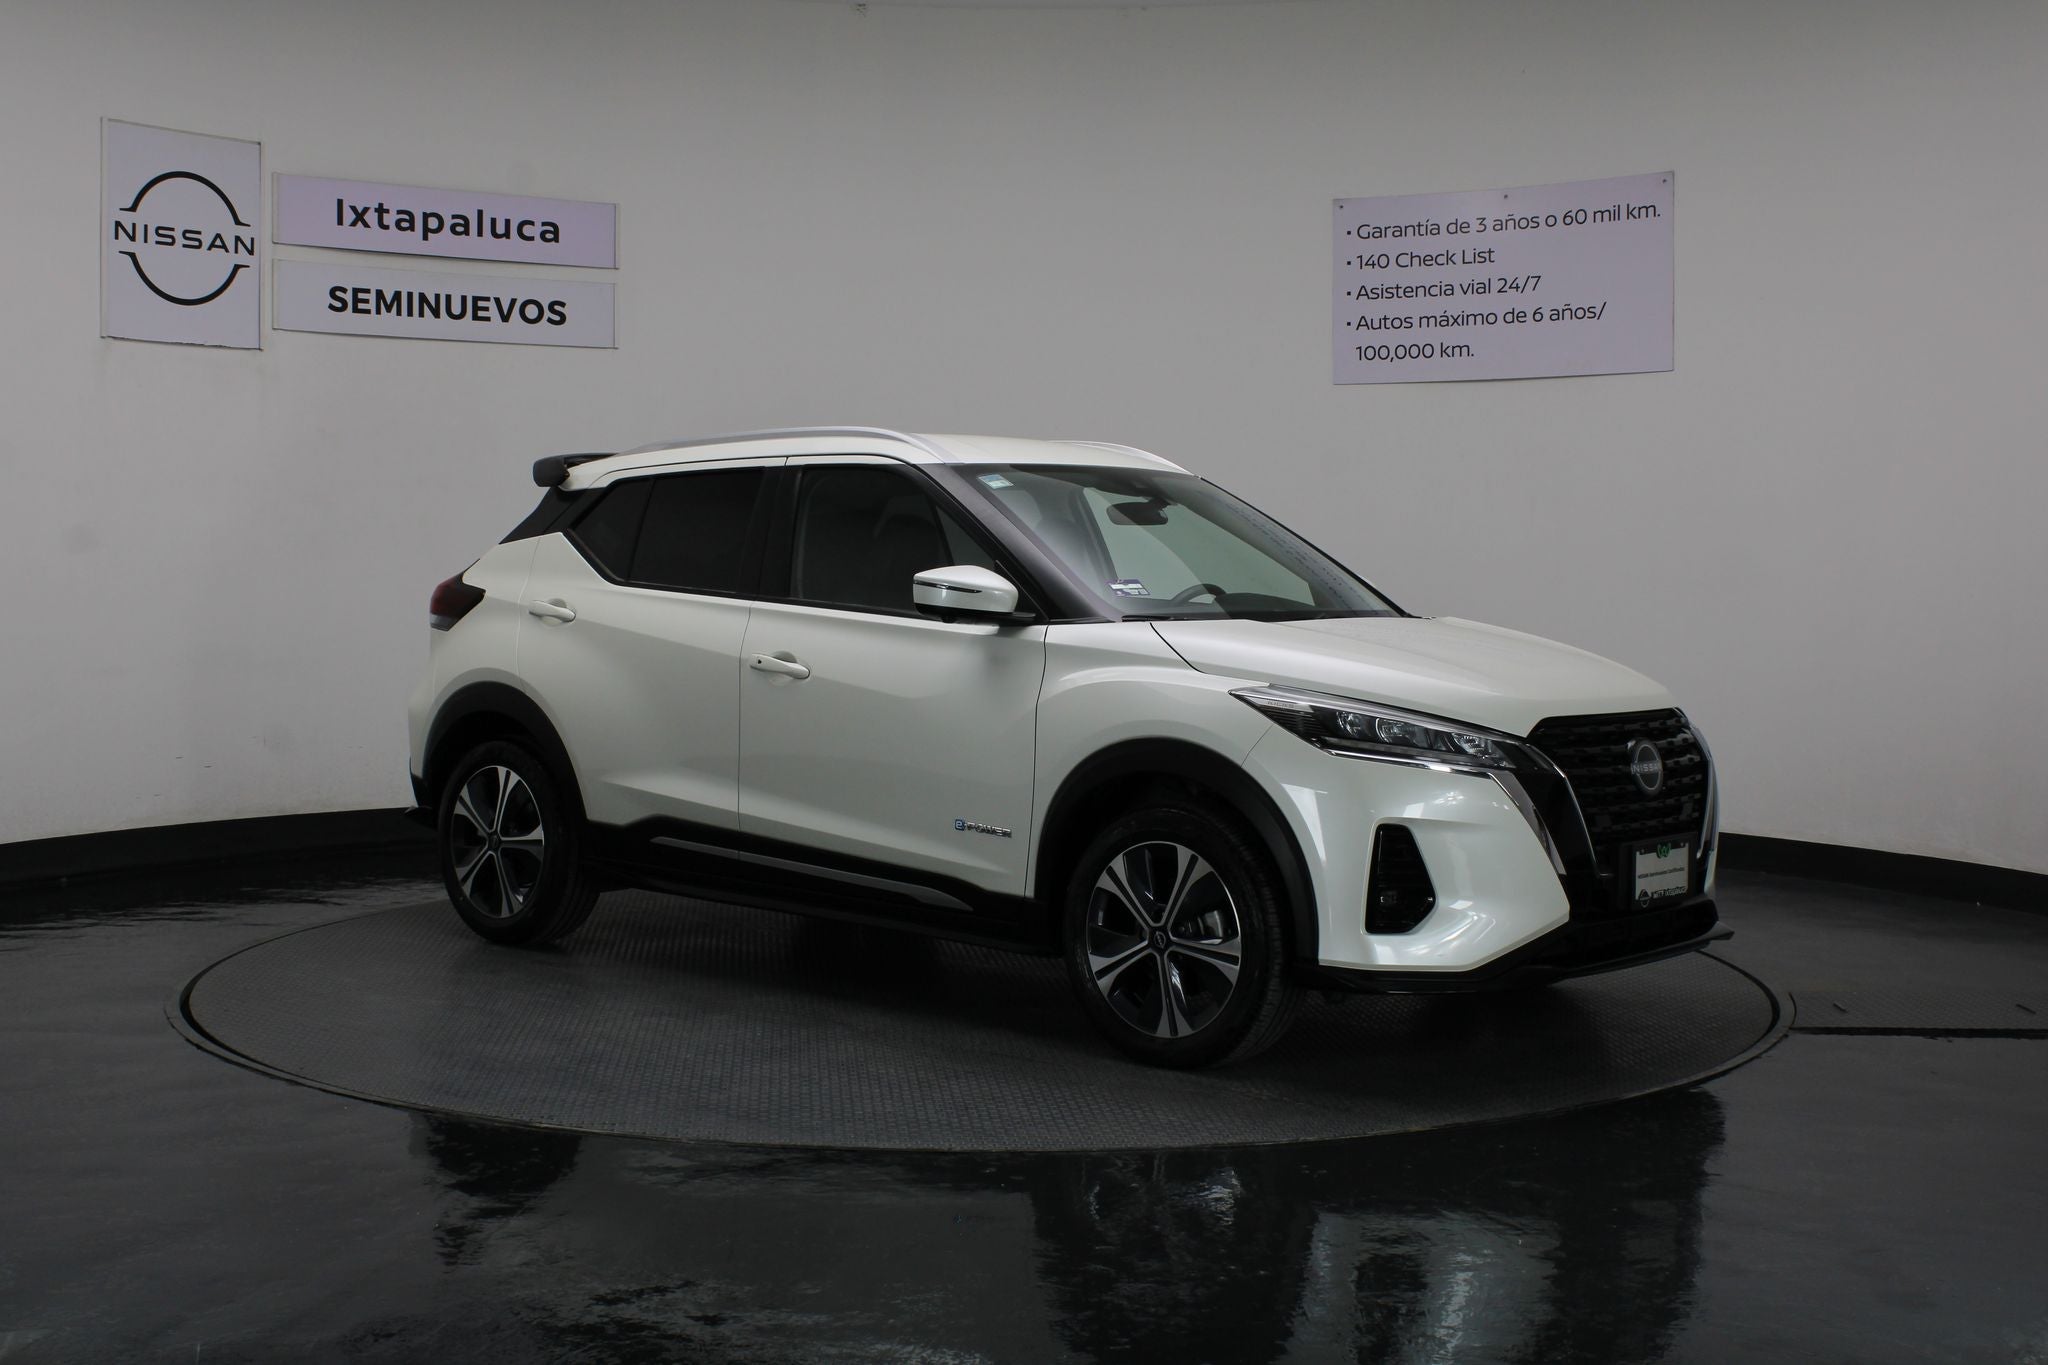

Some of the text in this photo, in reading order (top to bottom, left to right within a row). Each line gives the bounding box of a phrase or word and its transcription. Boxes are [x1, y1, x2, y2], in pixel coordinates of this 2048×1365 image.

[336, 198, 560, 244] Ixtapaluca
[1356, 202, 1661, 240] Garantía de 3 años o 60 mil km.
[114, 220, 255, 257] NISSAN
[1356, 247, 1496, 271] 140 Check List
[1355, 274, 1542, 301] Asistencia vial 24/7
[327, 285, 567, 326] SEMINUEVOS
[1355, 300, 1608, 332] Autos máximo de 6 años/
[1355, 341, 1475, 363] 100,000 km.
